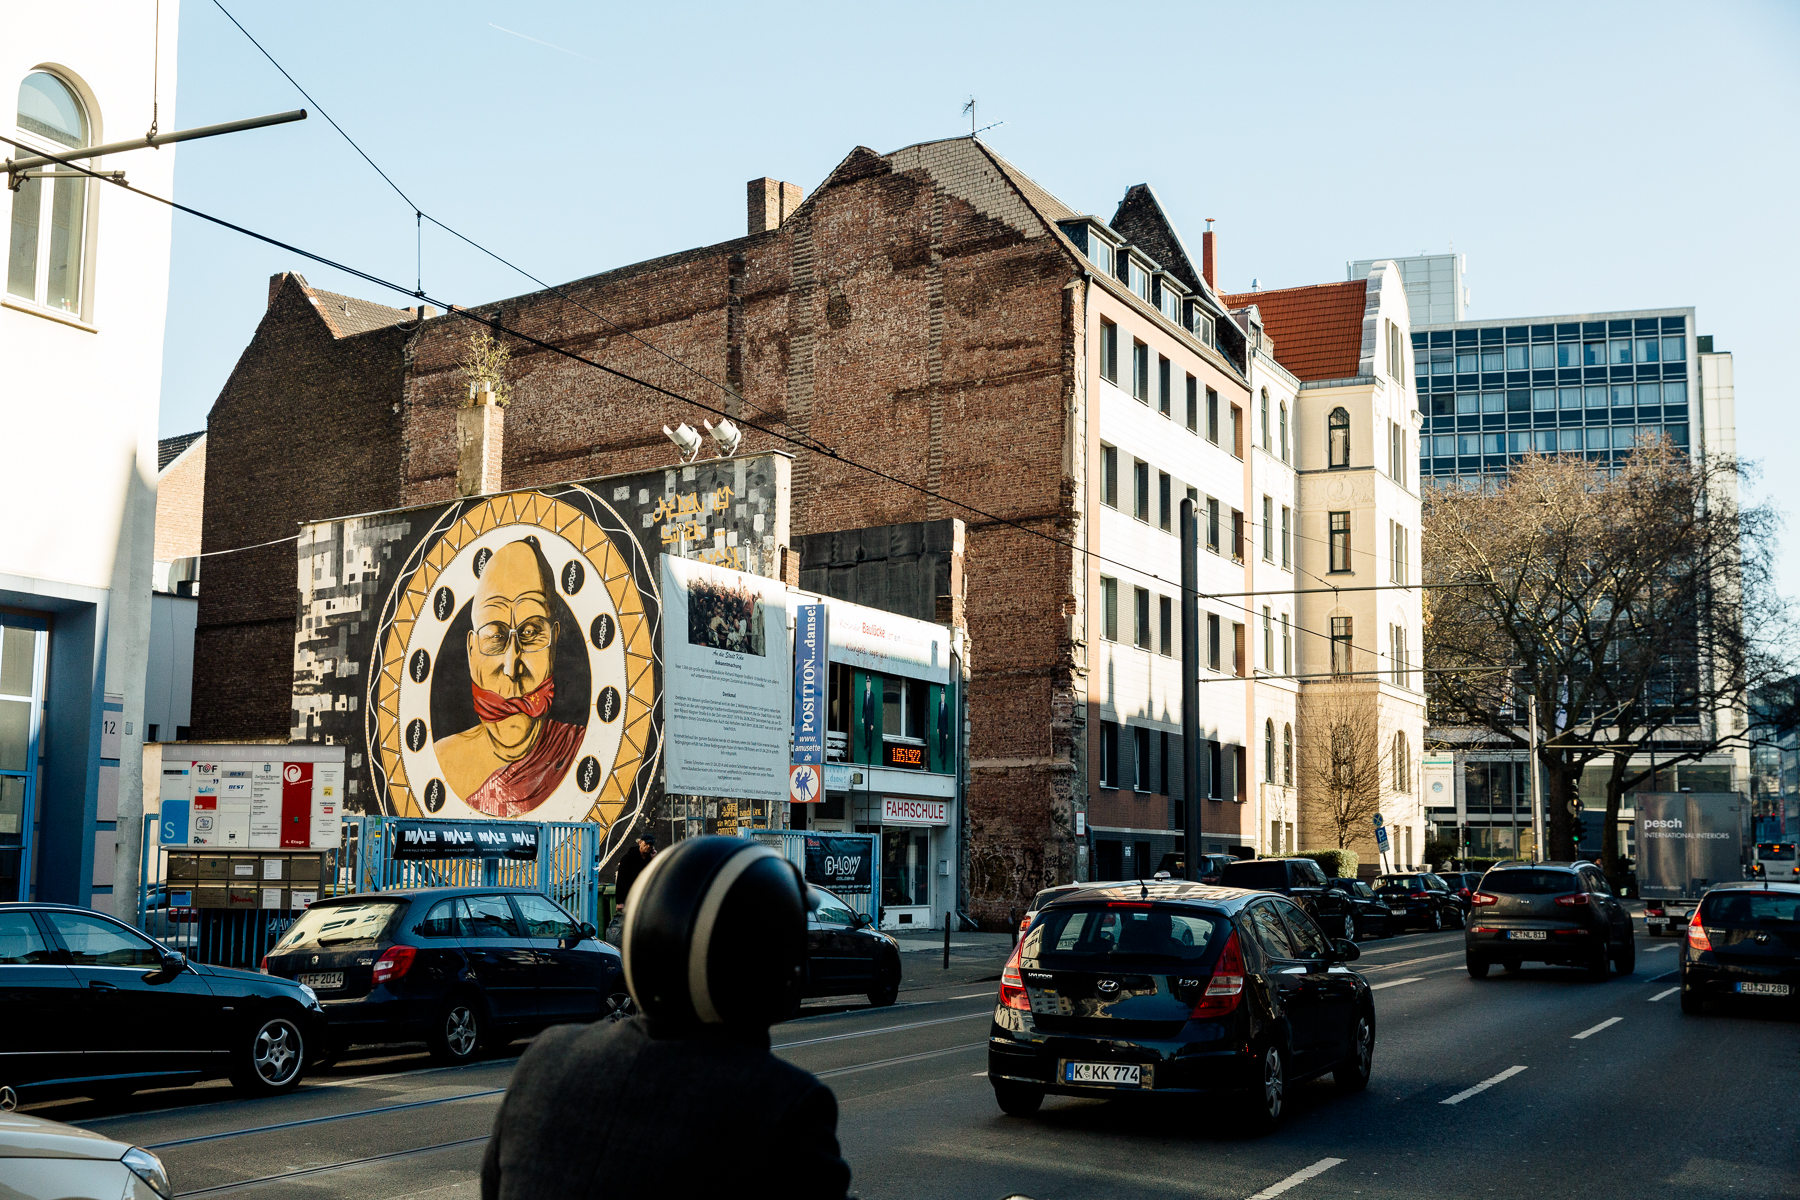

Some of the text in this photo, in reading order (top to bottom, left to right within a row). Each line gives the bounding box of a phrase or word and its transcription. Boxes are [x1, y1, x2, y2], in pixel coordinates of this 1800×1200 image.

[862, 622, 886, 638] Baulücke
[104, 721, 116, 735] 12
[795, 744, 821, 752] amusette
[886, 801, 944, 819] FAHRSCHULE
[164, 821, 175, 839] S
[1644, 818, 1682, 830] pesch
[404, 827, 437, 844] MALE
[443, 828, 474, 845] MALE
[477, 829, 508, 845] MALE
[511, 830, 536, 847] MALE
[1377, 830, 1385, 842] P
[825, 855, 861, 875] B-LOW
[1533, 931, 1546, 939] 811
[308, 974, 319, 984] FF
[320, 972, 343, 984] 2014
[1741, 982, 1753, 991] EU
[1074, 1064, 1139, 1082] K KK 774
